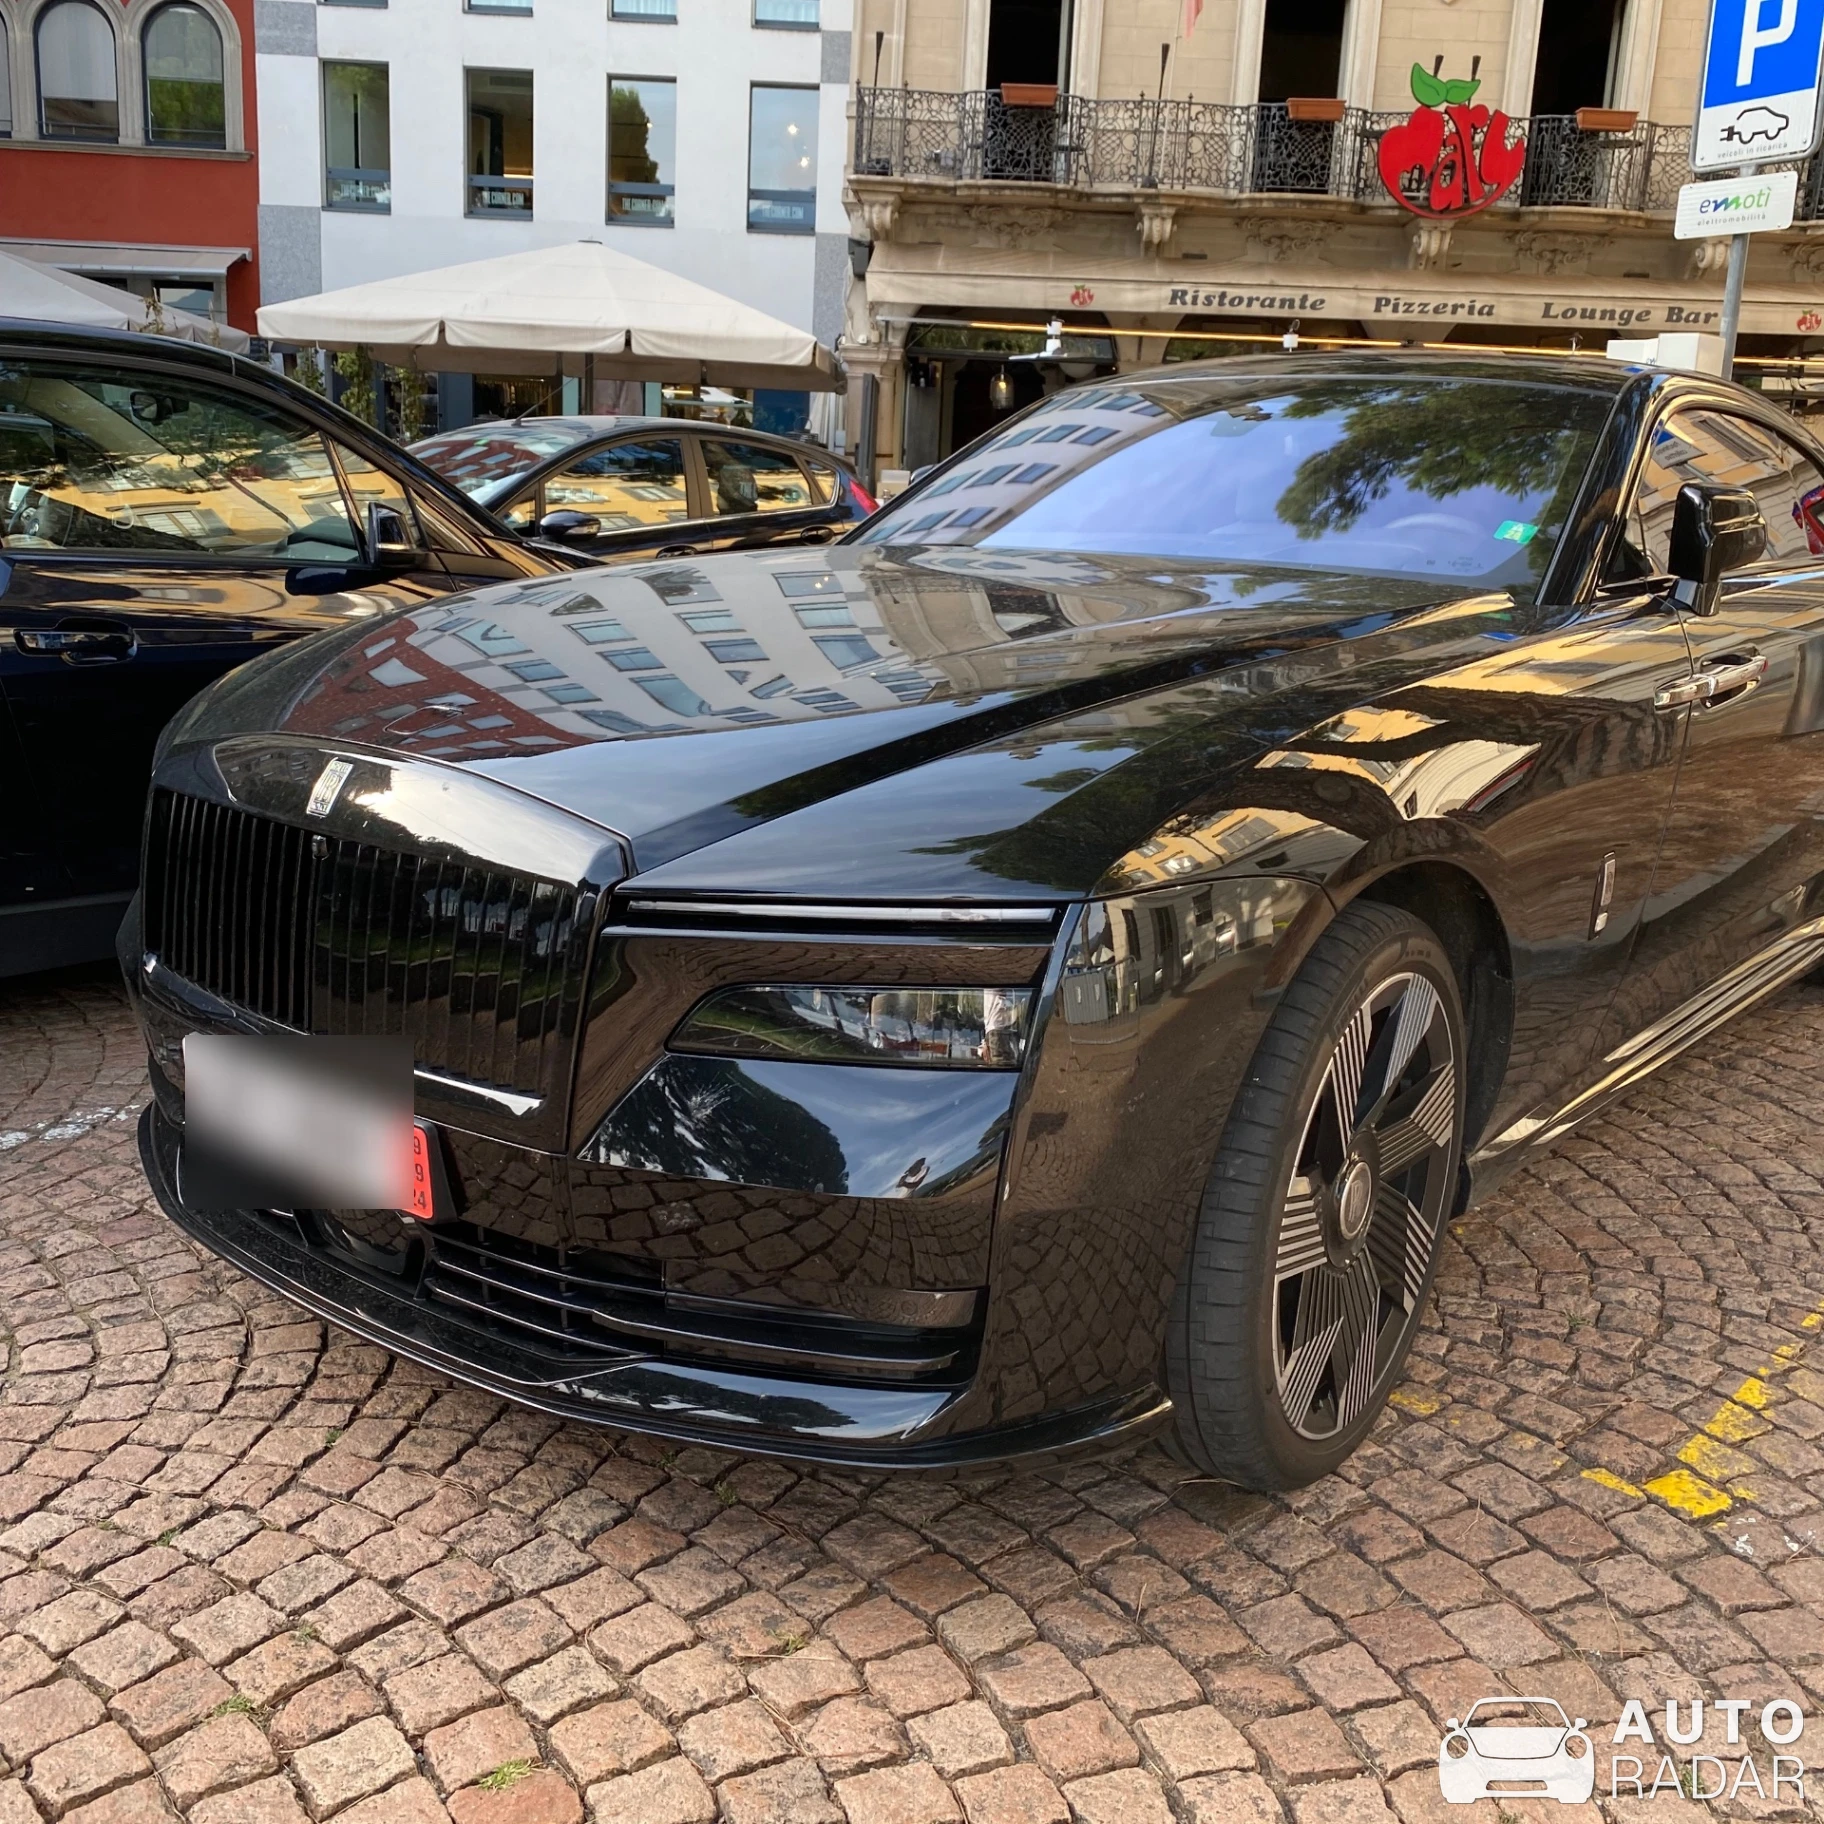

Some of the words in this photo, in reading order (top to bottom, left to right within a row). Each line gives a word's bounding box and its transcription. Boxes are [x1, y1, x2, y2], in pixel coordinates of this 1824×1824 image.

[1735, 0, 1798, 87] P
[1717, 148, 1744, 158] veicoli
[1756, 142, 1788, 152] ricarica
[1699, 186, 1772, 214] emotì
[1169, 288, 1326, 311] Ristorante
[1373, 297, 1496, 317] Pizzeria
[1541, 302, 1651, 326] Lounge
[1664, 306, 1719, 325] Bar
